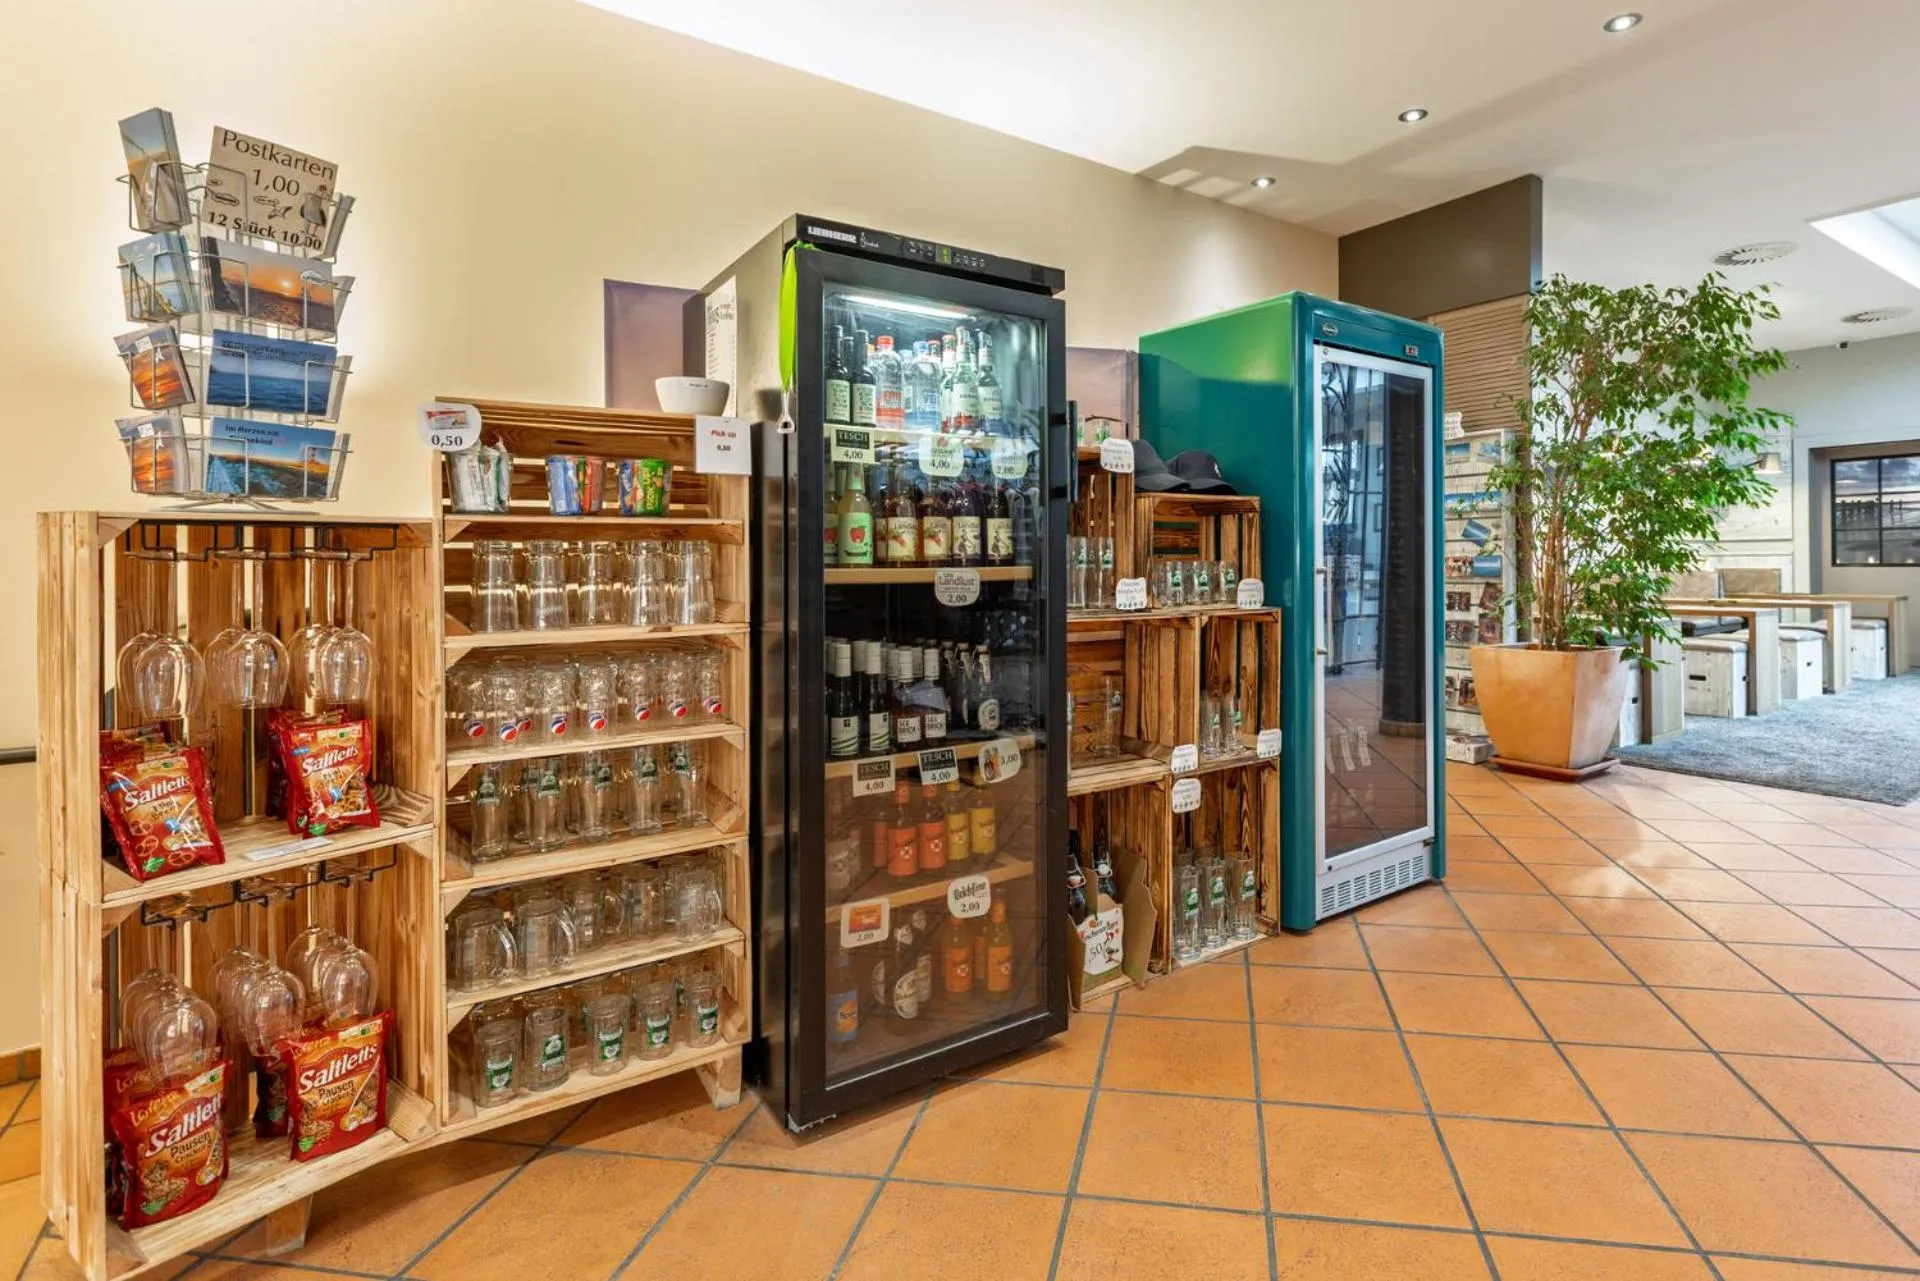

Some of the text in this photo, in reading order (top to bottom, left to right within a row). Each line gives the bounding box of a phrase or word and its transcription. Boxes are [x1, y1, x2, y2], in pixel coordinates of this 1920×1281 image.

[221, 129, 335, 181] Postkarten
[252, 168, 300, 197] 1,00
[208, 211, 228, 227] 12
[232, 217, 276, 239] Sück
[431, 434, 463, 447] 0,50
[842, 449, 864, 460] 4,00
